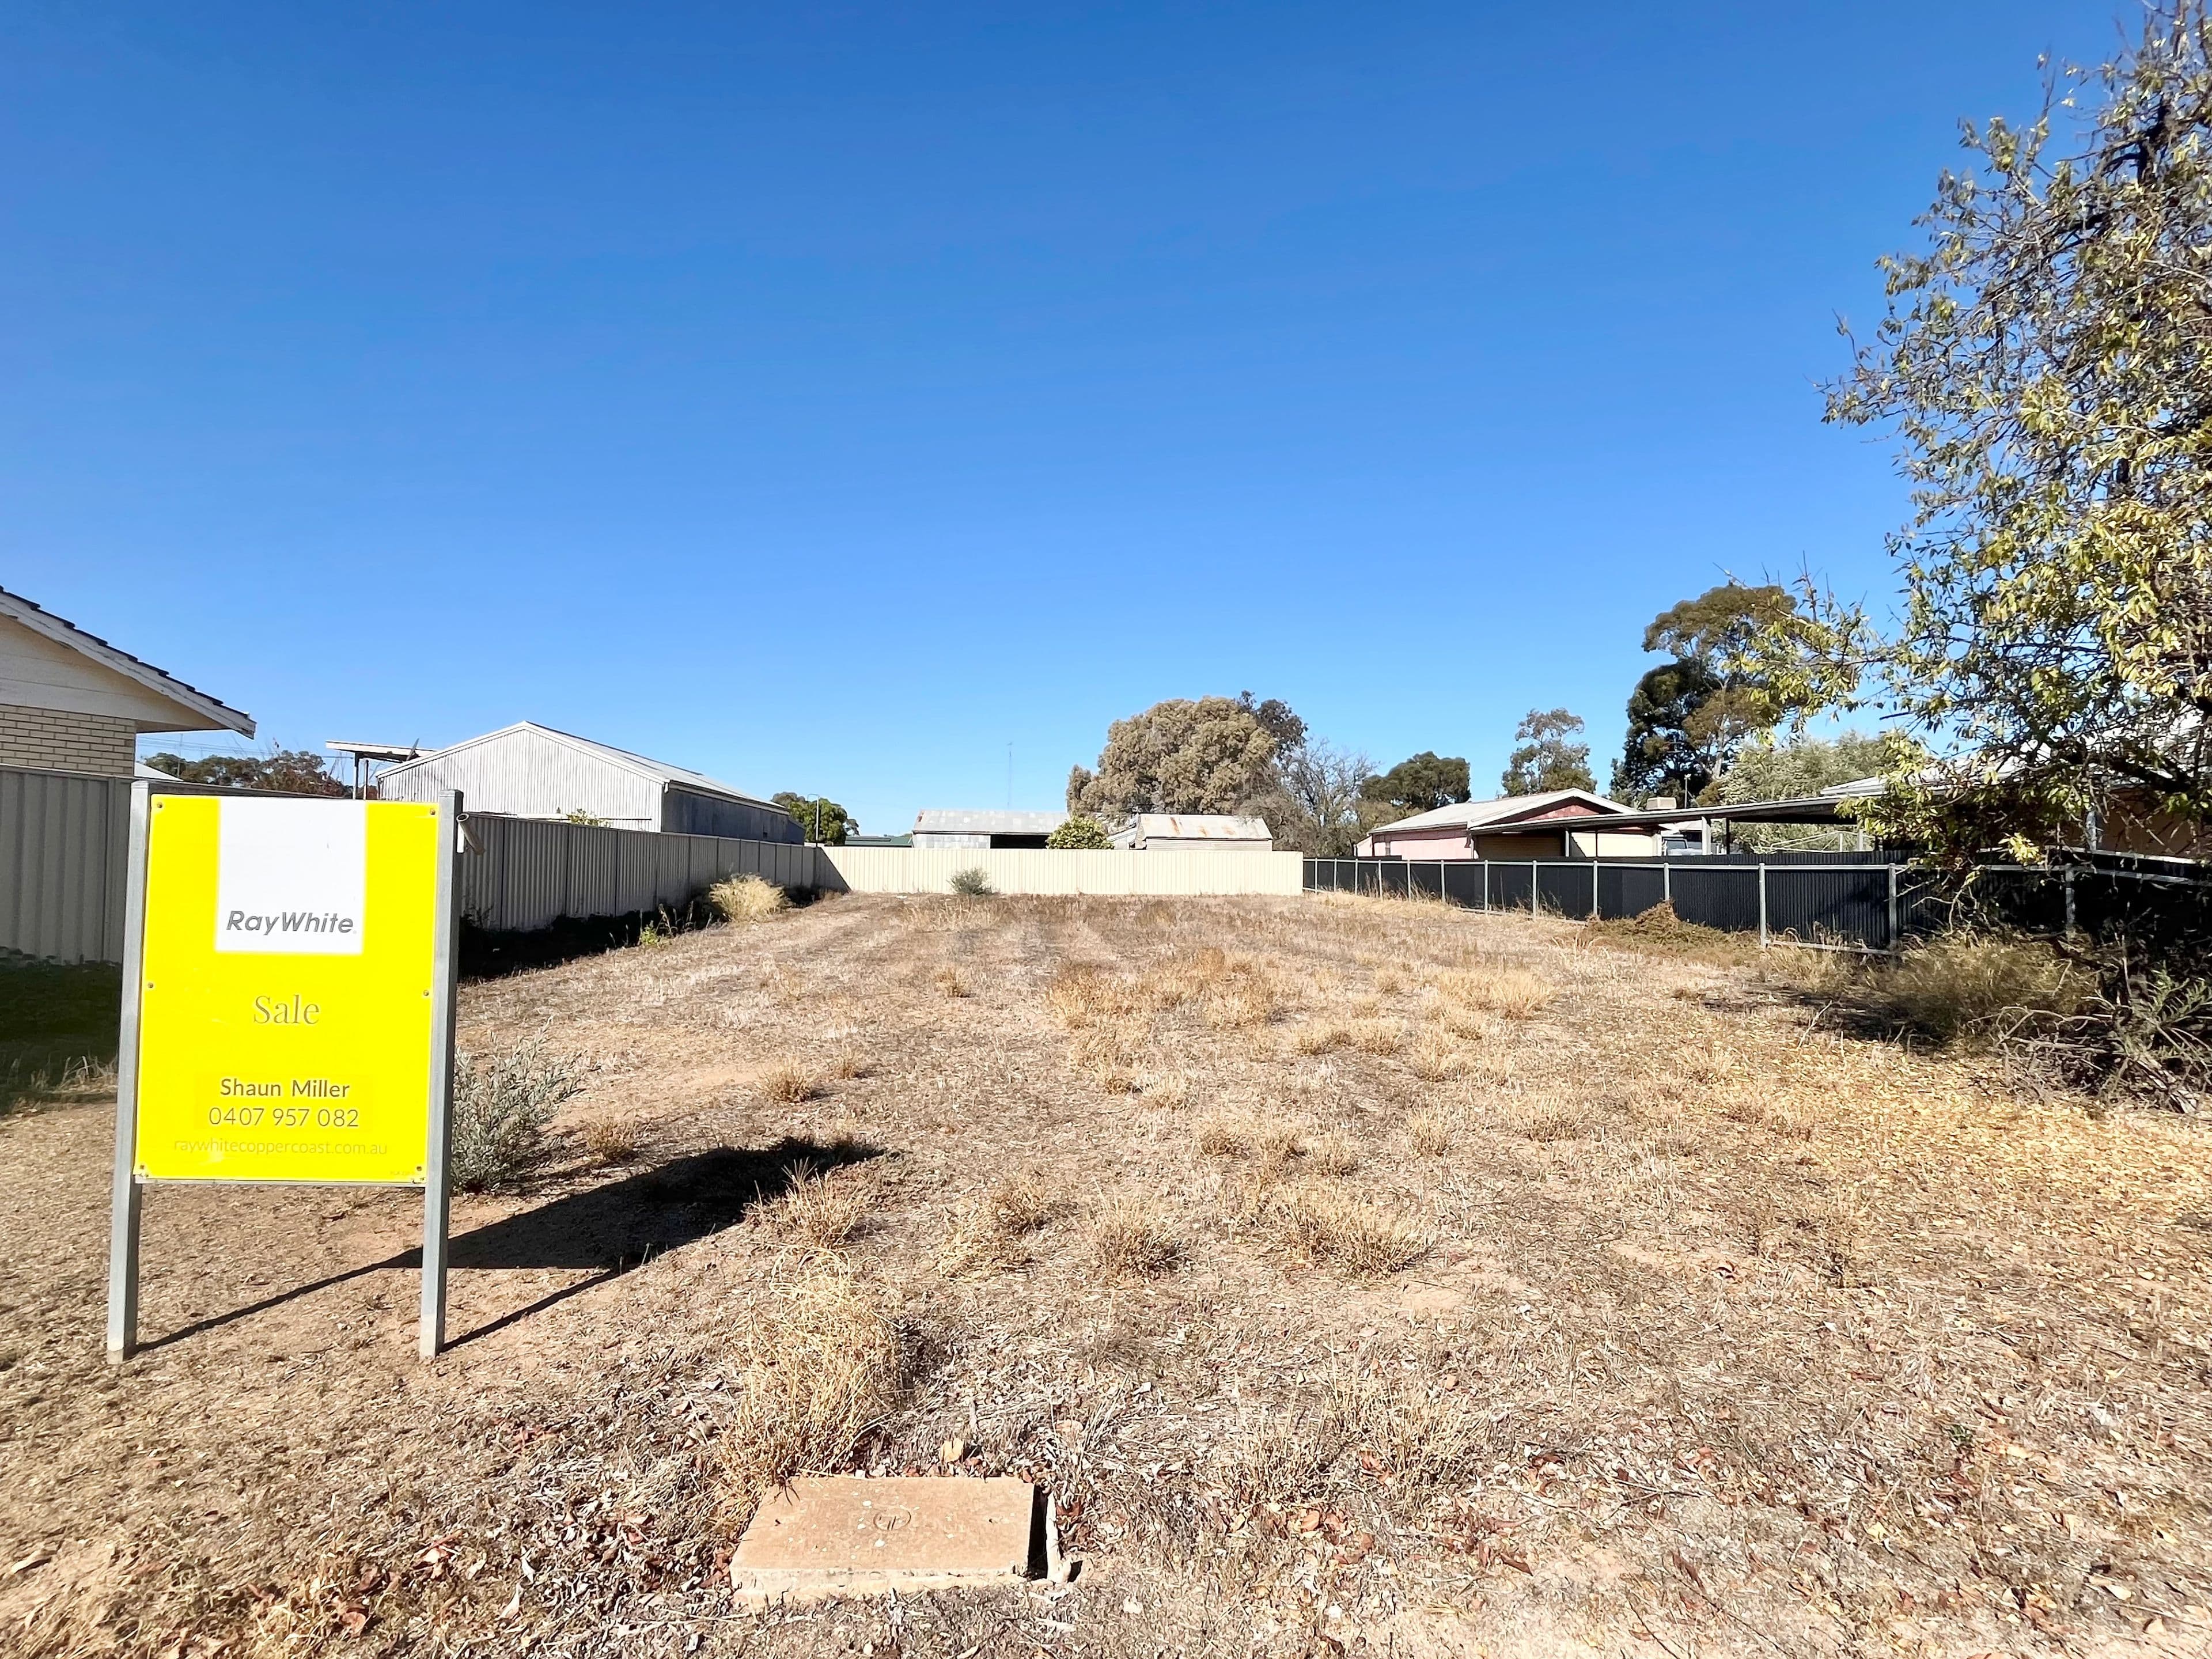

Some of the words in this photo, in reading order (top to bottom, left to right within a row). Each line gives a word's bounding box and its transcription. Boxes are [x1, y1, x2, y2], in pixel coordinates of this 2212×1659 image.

[253, 994, 320, 1024] Sale
[220, 1078, 281, 1096] Shaun
[291, 1080, 350, 1097] Miller
[209, 1107, 265, 1126] 0407
[272, 1108, 310, 1126] 957
[317, 1109, 359, 1127] 082
[173, 1138, 388, 1156] raywhitecoppercoast.com.au
